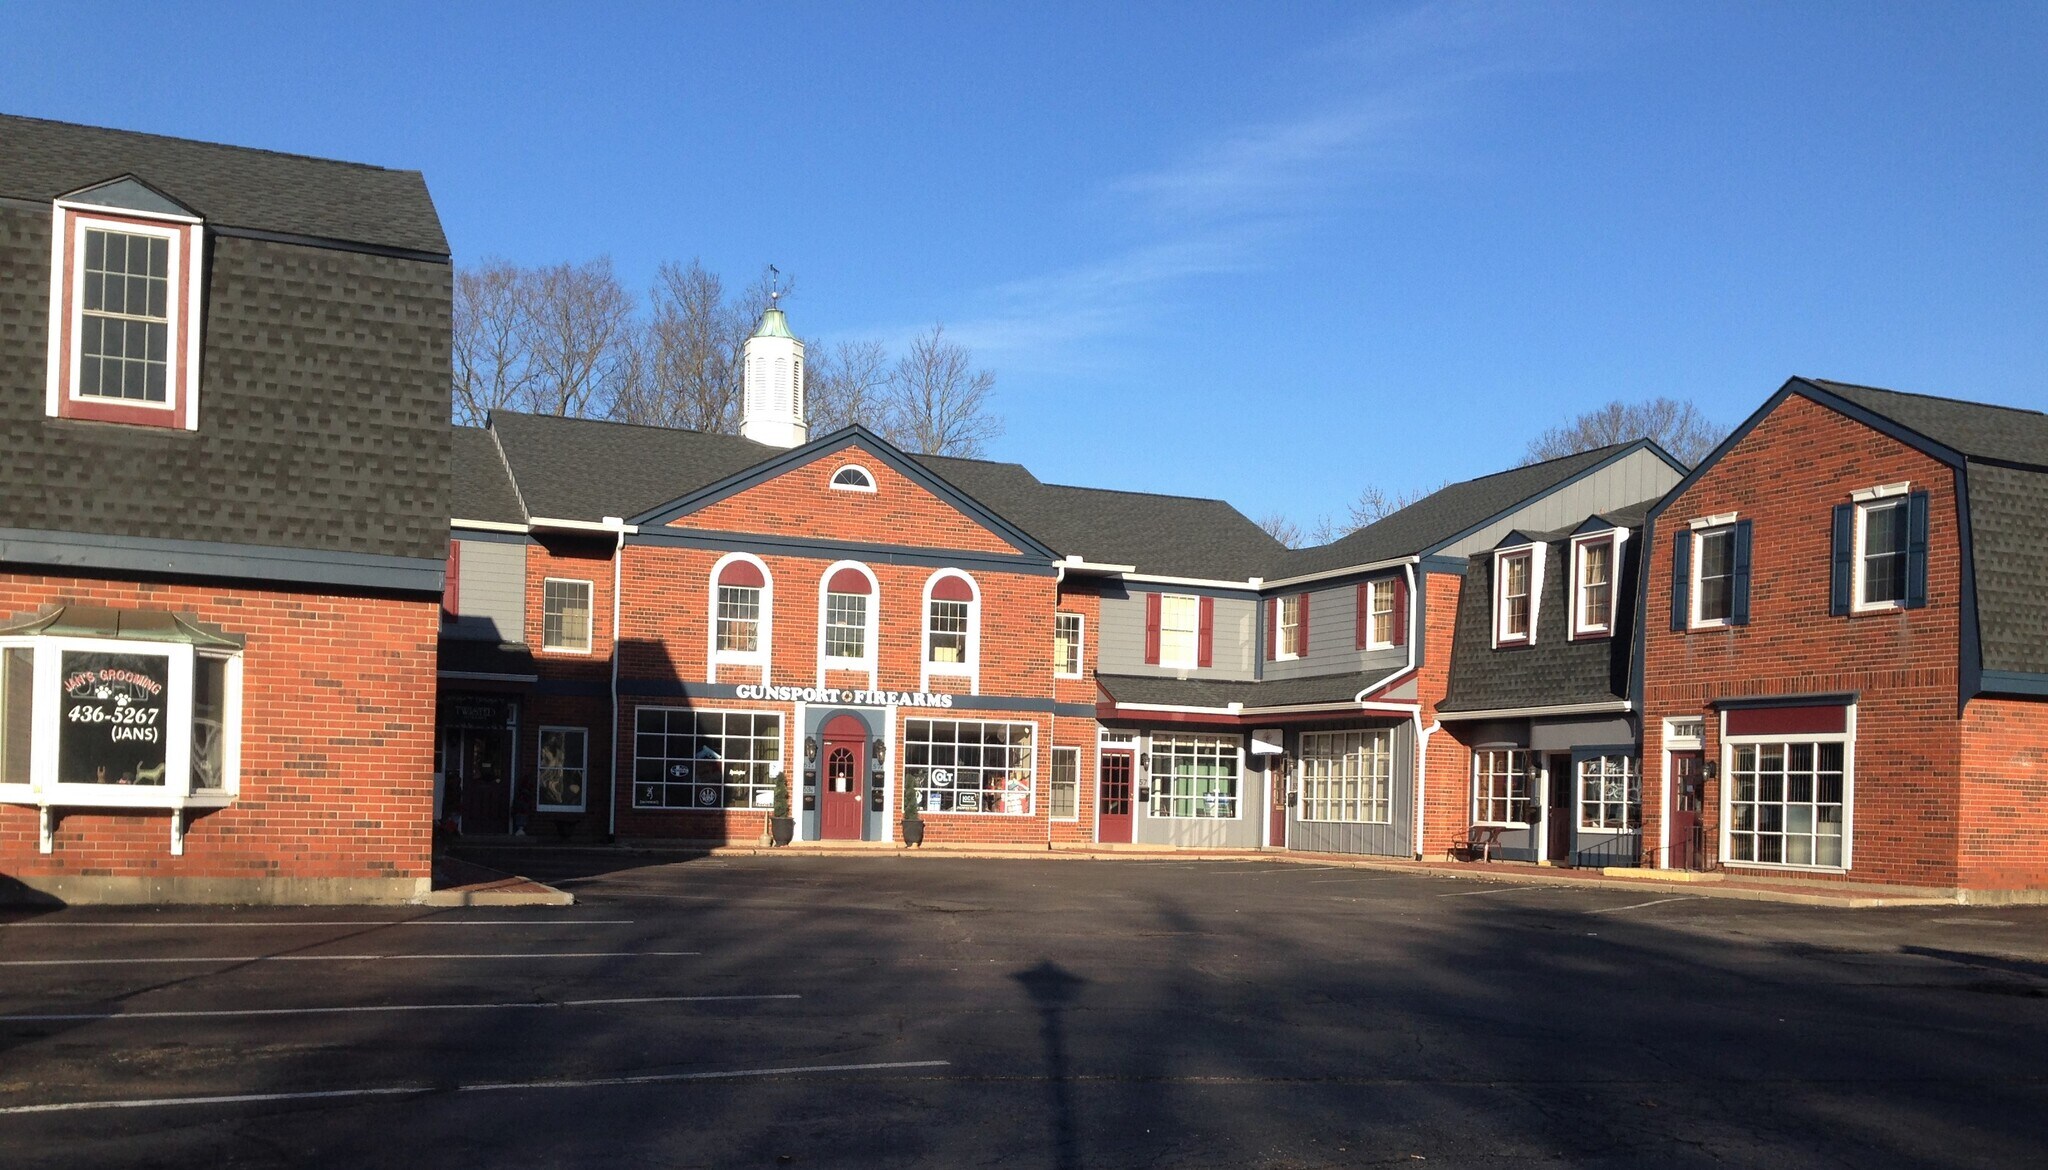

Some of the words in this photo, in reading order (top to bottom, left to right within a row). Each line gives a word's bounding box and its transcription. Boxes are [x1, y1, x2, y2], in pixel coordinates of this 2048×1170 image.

[64, 671, 95, 692] JAN'S
[100, 669, 162, 695] GROOMING
[735, 684, 841, 703] GUNSPORT
[853, 689, 953, 708] FIREARMS
[68, 705, 159, 725] 436-5267
[111, 725, 158, 743] (JANS)
[931, 768, 954, 787] COLT
